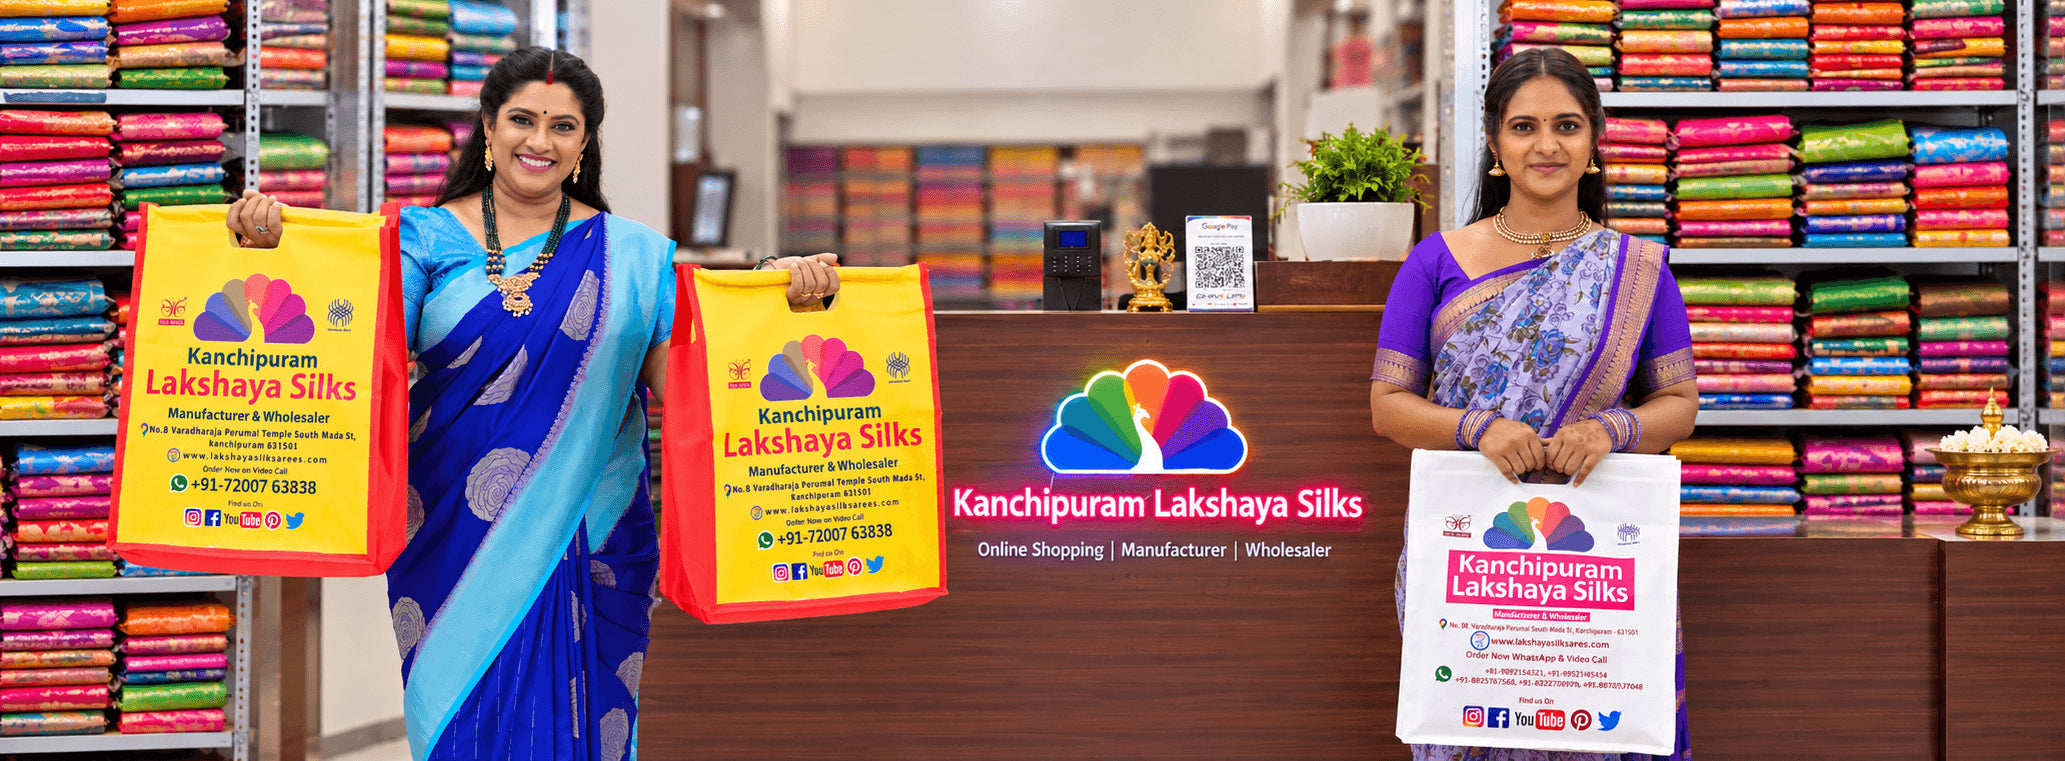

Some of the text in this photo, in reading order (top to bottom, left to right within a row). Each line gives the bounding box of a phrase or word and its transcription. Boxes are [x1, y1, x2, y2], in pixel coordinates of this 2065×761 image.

[188, 347, 318, 371] Kanchipuram
[146, 368, 356, 405] Lakshaya Silks
[168, 407, 330, 424] Manufacturer & Wholesaler
[758, 405, 882, 425] Kanchipuram
[171, 426, 222, 437] Varadharaja
[224, 428, 259, 438] Perumal
[262, 429, 292, 439] Temple
[294, 430, 319, 439] South
[321, 431, 344, 440] Mada
[345, 432, 356, 441] St,
[724, 421, 922, 458] Lakshaya Silks
[274, 467, 288, 475] Call
[749, 458, 898, 477] Manufacturer & Wholesaler
[191, 477, 317, 494] +91-72007 63838
[753, 481, 800, 492] Varadharaja
[837, 477, 866, 488] Temple
[867, 475, 891, 485] South
[893, 474, 913, 483] Mada
[953, 488, 1363, 525] Kanchipuram Lakshaya Silks
[777, 523, 893, 545] +91-72007 63838
[978, 542, 1332, 561] Online Shopping Manufacturer Wholesaler
[1459, 554, 1623, 581] Kanchipuram
[1452, 575, 1629, 605] Lakshaya Silks
[1465, 650, 1489, 660] Order
[1558, 654, 1565, 662] &
[1566, 655, 1590, 663] Video
[1591, 655, 1608, 664] Call
[1519, 696, 1534, 704] Find
[1543, 697, 1554, 705] On
[1515, 709, 1565, 730] YouTube
